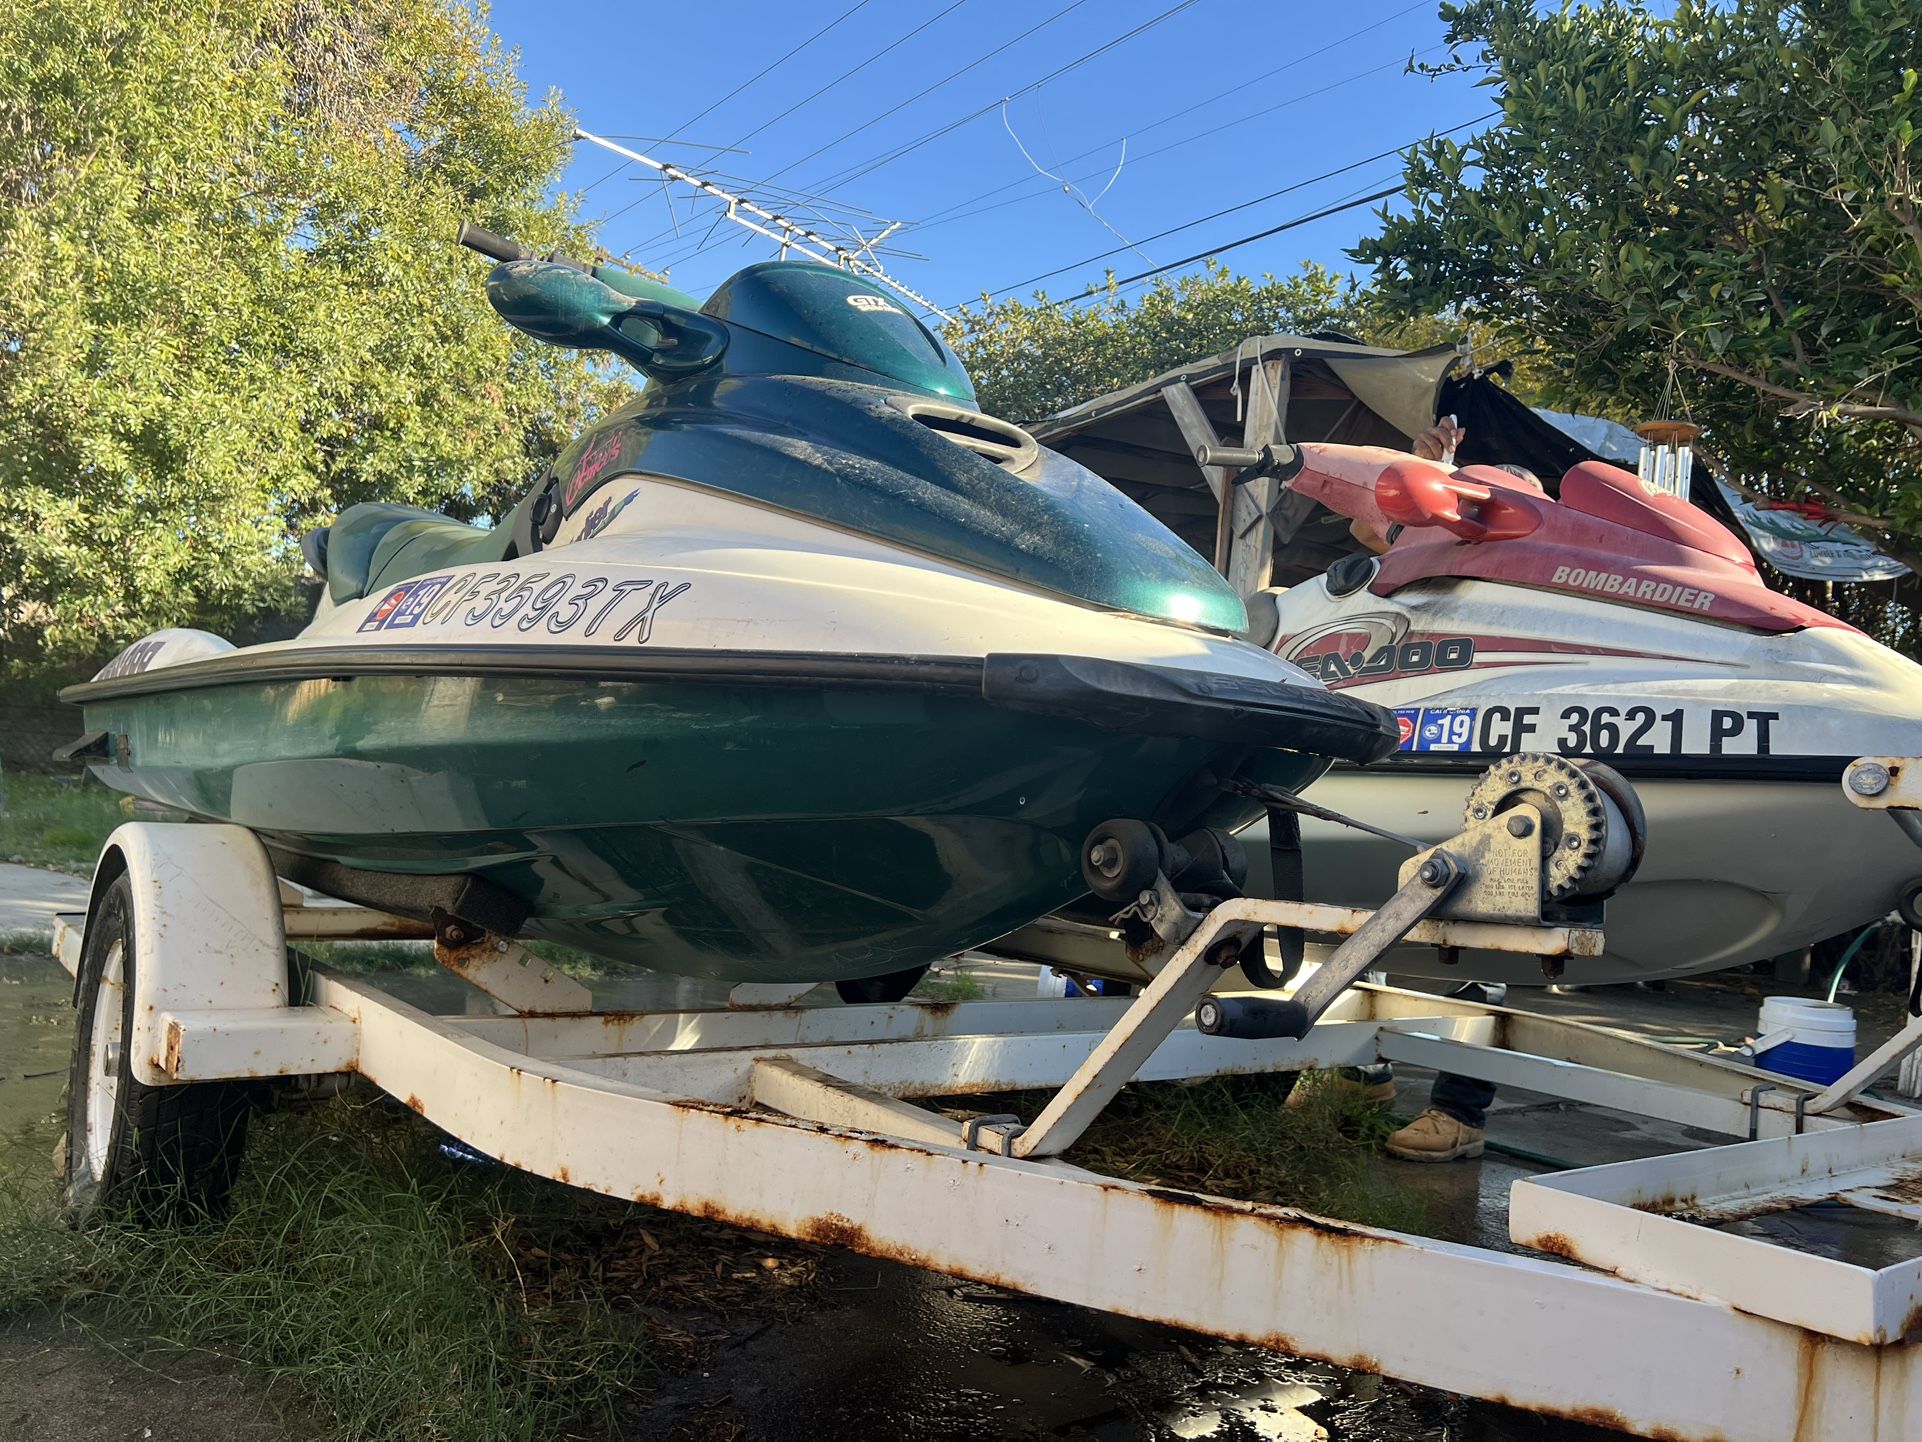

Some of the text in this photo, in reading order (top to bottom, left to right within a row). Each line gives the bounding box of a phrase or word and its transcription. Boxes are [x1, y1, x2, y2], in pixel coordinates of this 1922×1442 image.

[405, 584, 441, 615] 19
[1552, 565, 1716, 611] BOMBARDIER
[422, 572, 692, 644] CF3593TX
[1437, 714, 1471, 744] 19
[1479, 705, 1780, 755] CF 3621 PT
[1487, 858, 1533, 867] MOVEMENT
[1492, 849, 1529, 857] NOT FOR
[1500, 867, 1534, 876] HUMANS
